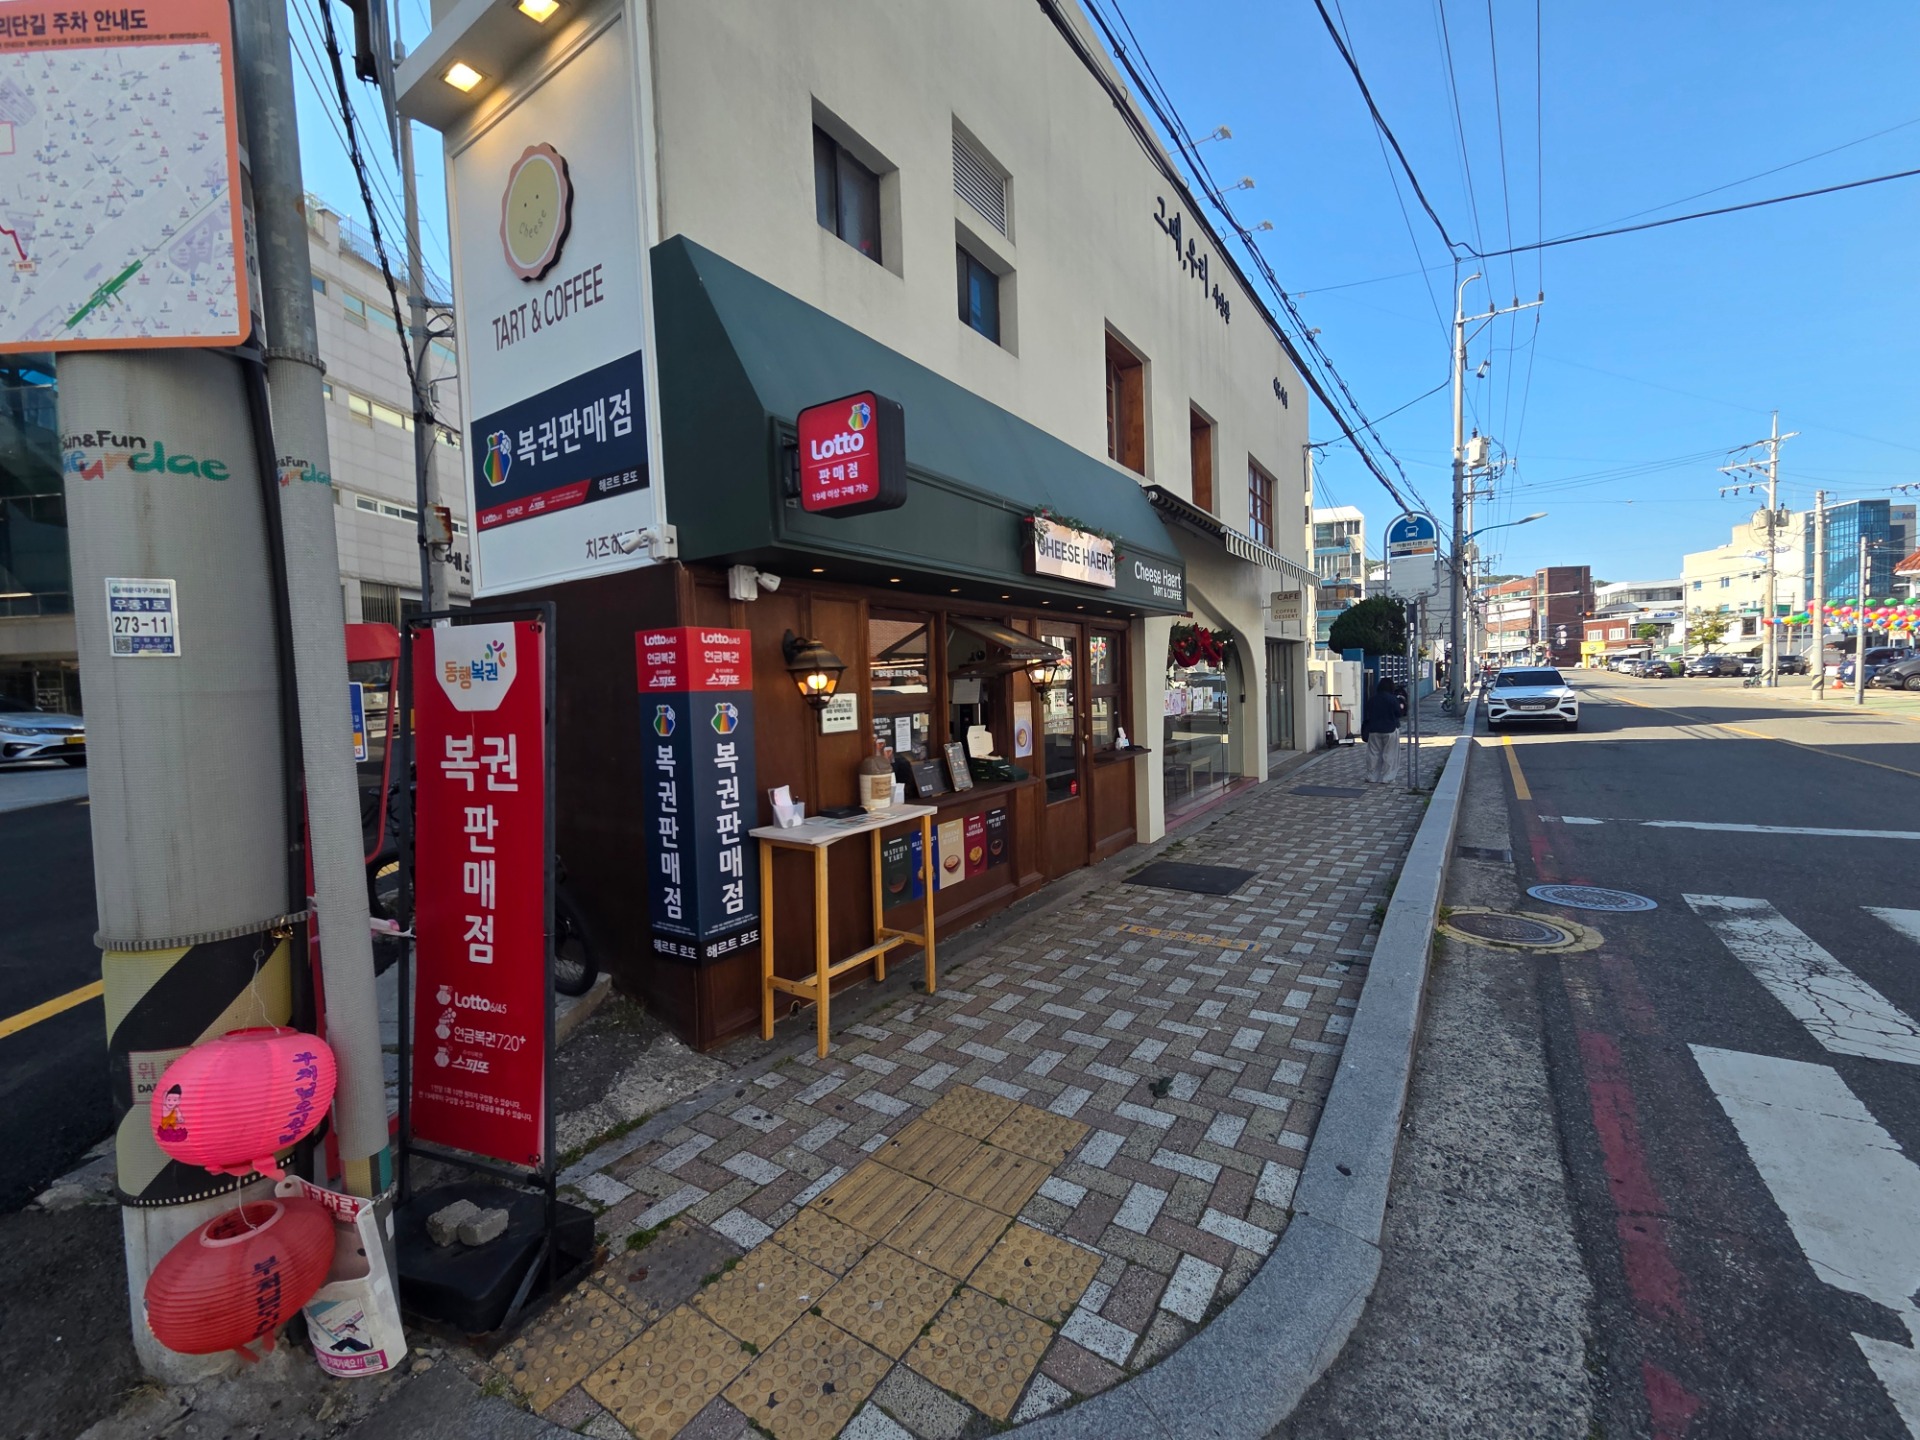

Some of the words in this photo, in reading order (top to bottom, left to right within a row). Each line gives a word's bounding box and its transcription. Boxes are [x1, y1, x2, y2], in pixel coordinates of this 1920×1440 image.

[53, 11, 88, 33] 주차
[94, 9, 148, 32] 안내도
[519, 209, 547, 238] Cheese
[492, 303, 527, 351] TART
[531, 298, 542, 333] &
[544, 263, 604, 326] COFFEE
[516, 388, 633, 467] 복권판매점
[810, 432, 864, 460] Lotto
[622, 470, 639, 485] 로또
[827, 488, 840, 499] 이상
[855, 483, 869, 493] 가능
[1038, 537, 1080, 564] CHEESE
[1083, 547, 1114, 574] HAERT
[1134, 561, 1161, 584] Cheese
[1162, 568, 1181, 589] Haert
[114, 599, 167, 610] 우동1로
[1153, 585, 1164, 596] TART
[1167, 590, 1182, 601] COFFEE
[1277, 592, 1299, 601] CAFE
[114, 616, 167, 633] 273-11
[445, 660, 498, 690] 동행복권
[440, 733, 519, 792] 복권
[655, 745, 682, 920] 복권판매점
[714, 741, 744, 915] 복권판매점
[888, 853, 904, 863] TART
[740, 930, 760, 946] 로또
[679, 945, 697, 959] 로또
[451, 1055, 490, 1073] 스피또
